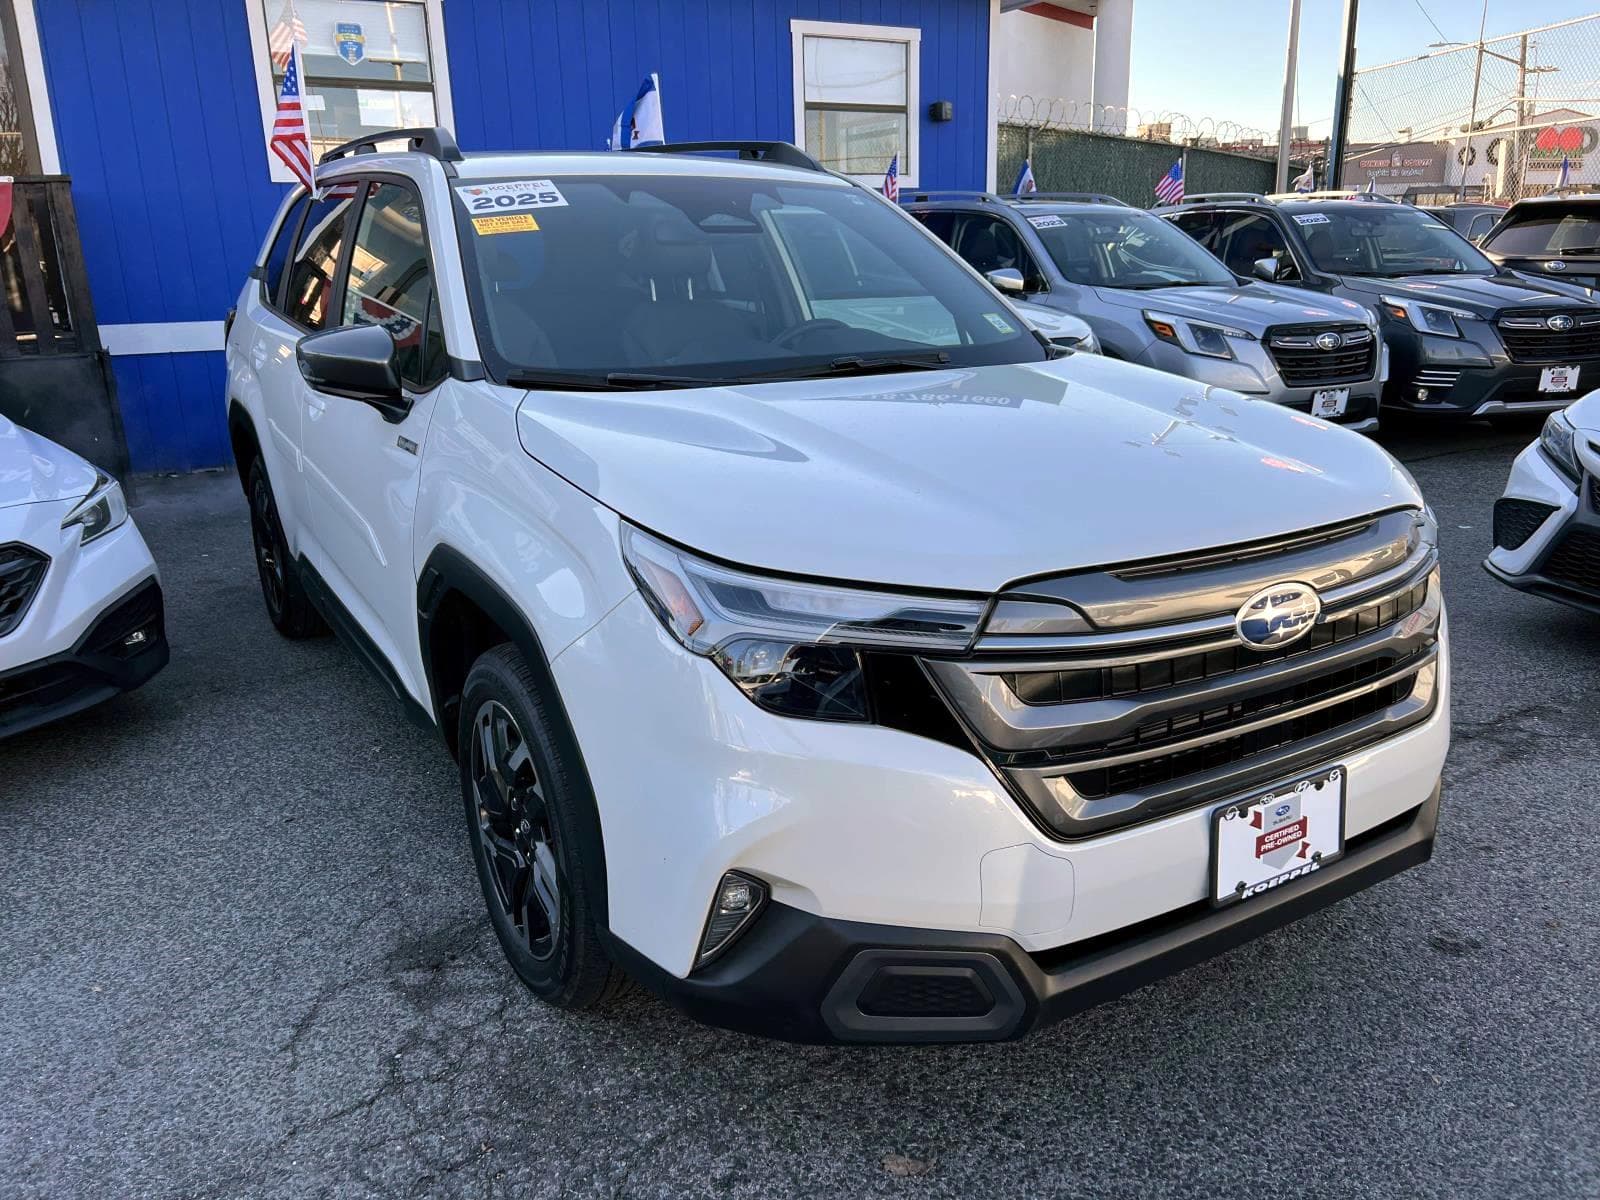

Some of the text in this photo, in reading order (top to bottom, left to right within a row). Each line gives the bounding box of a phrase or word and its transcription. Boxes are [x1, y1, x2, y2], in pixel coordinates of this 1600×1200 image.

[472, 192, 558, 209] 2025
[1260, 831, 1303, 852] PRE-OWNED
[1264, 824, 1300, 843] CERTIFIED
[1241, 861, 1320, 899] KOEPPEL
